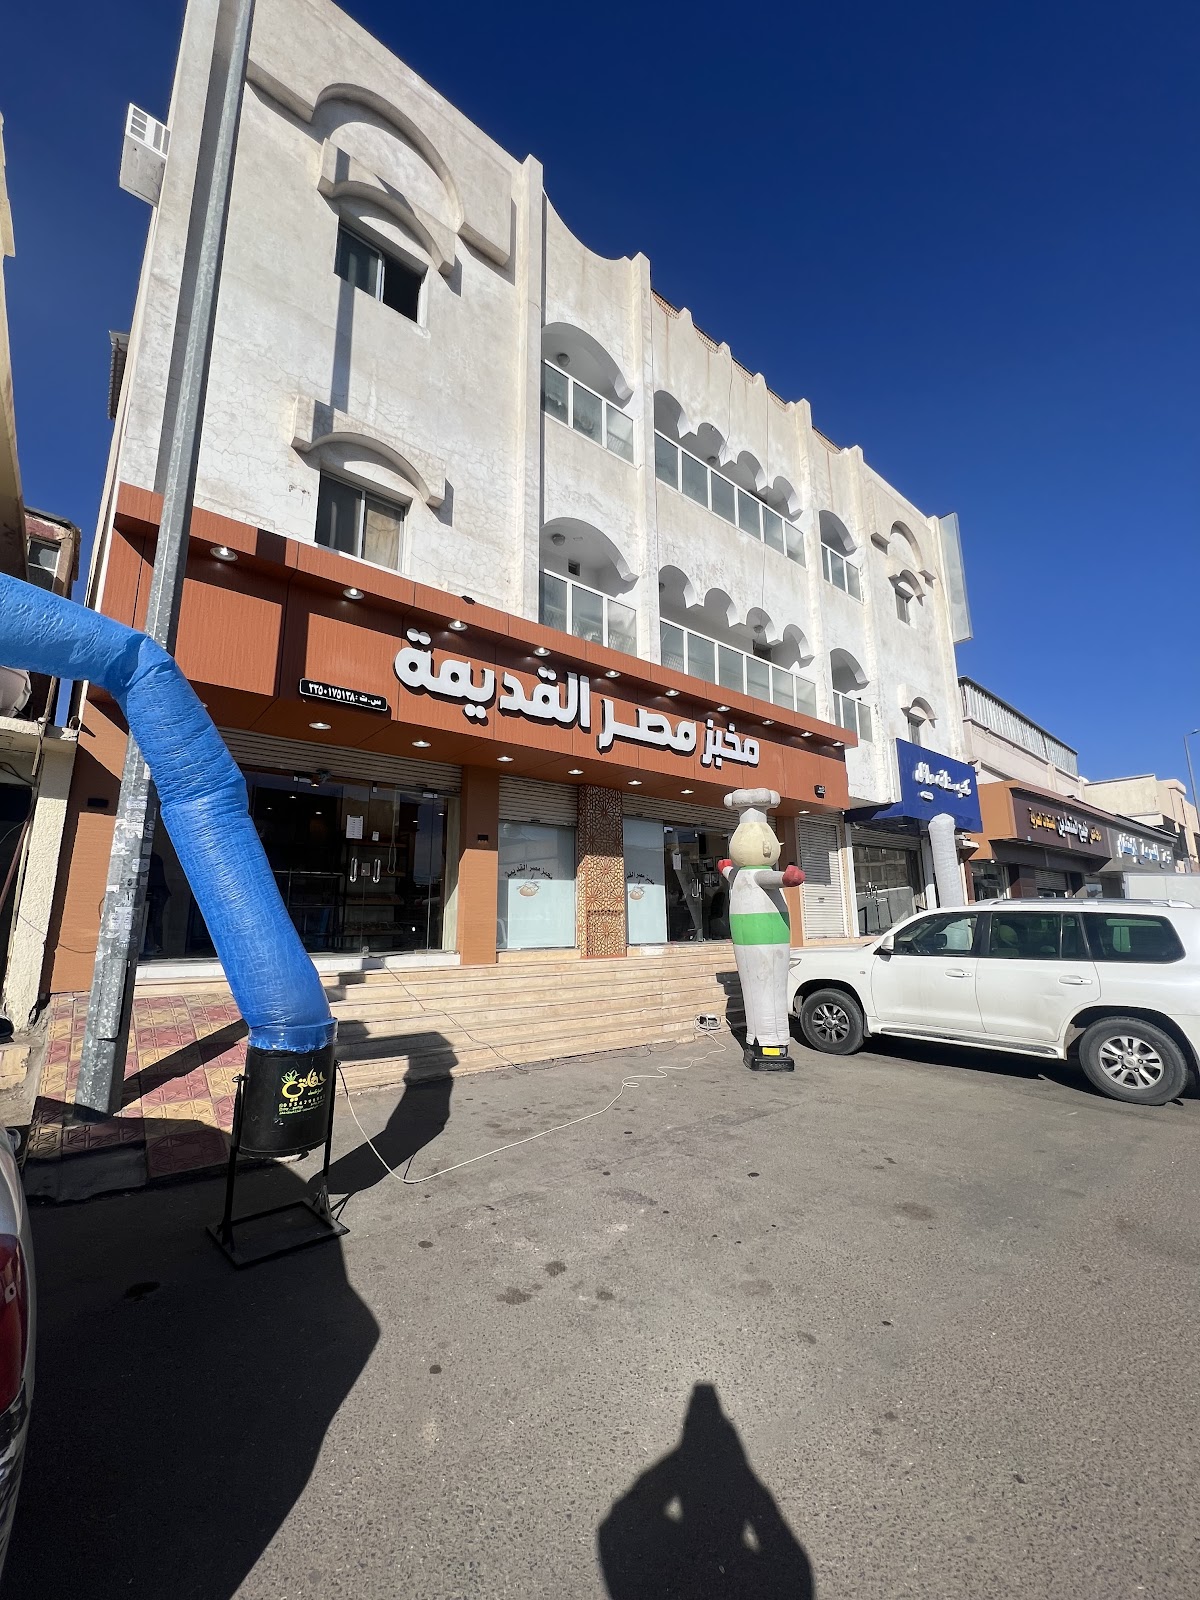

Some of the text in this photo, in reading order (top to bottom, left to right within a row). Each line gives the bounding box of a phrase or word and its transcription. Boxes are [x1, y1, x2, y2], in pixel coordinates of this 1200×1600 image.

[394, 627, 761, 765] مخبز مصر القديمة
[540, 867, 553, 879] مخبز
